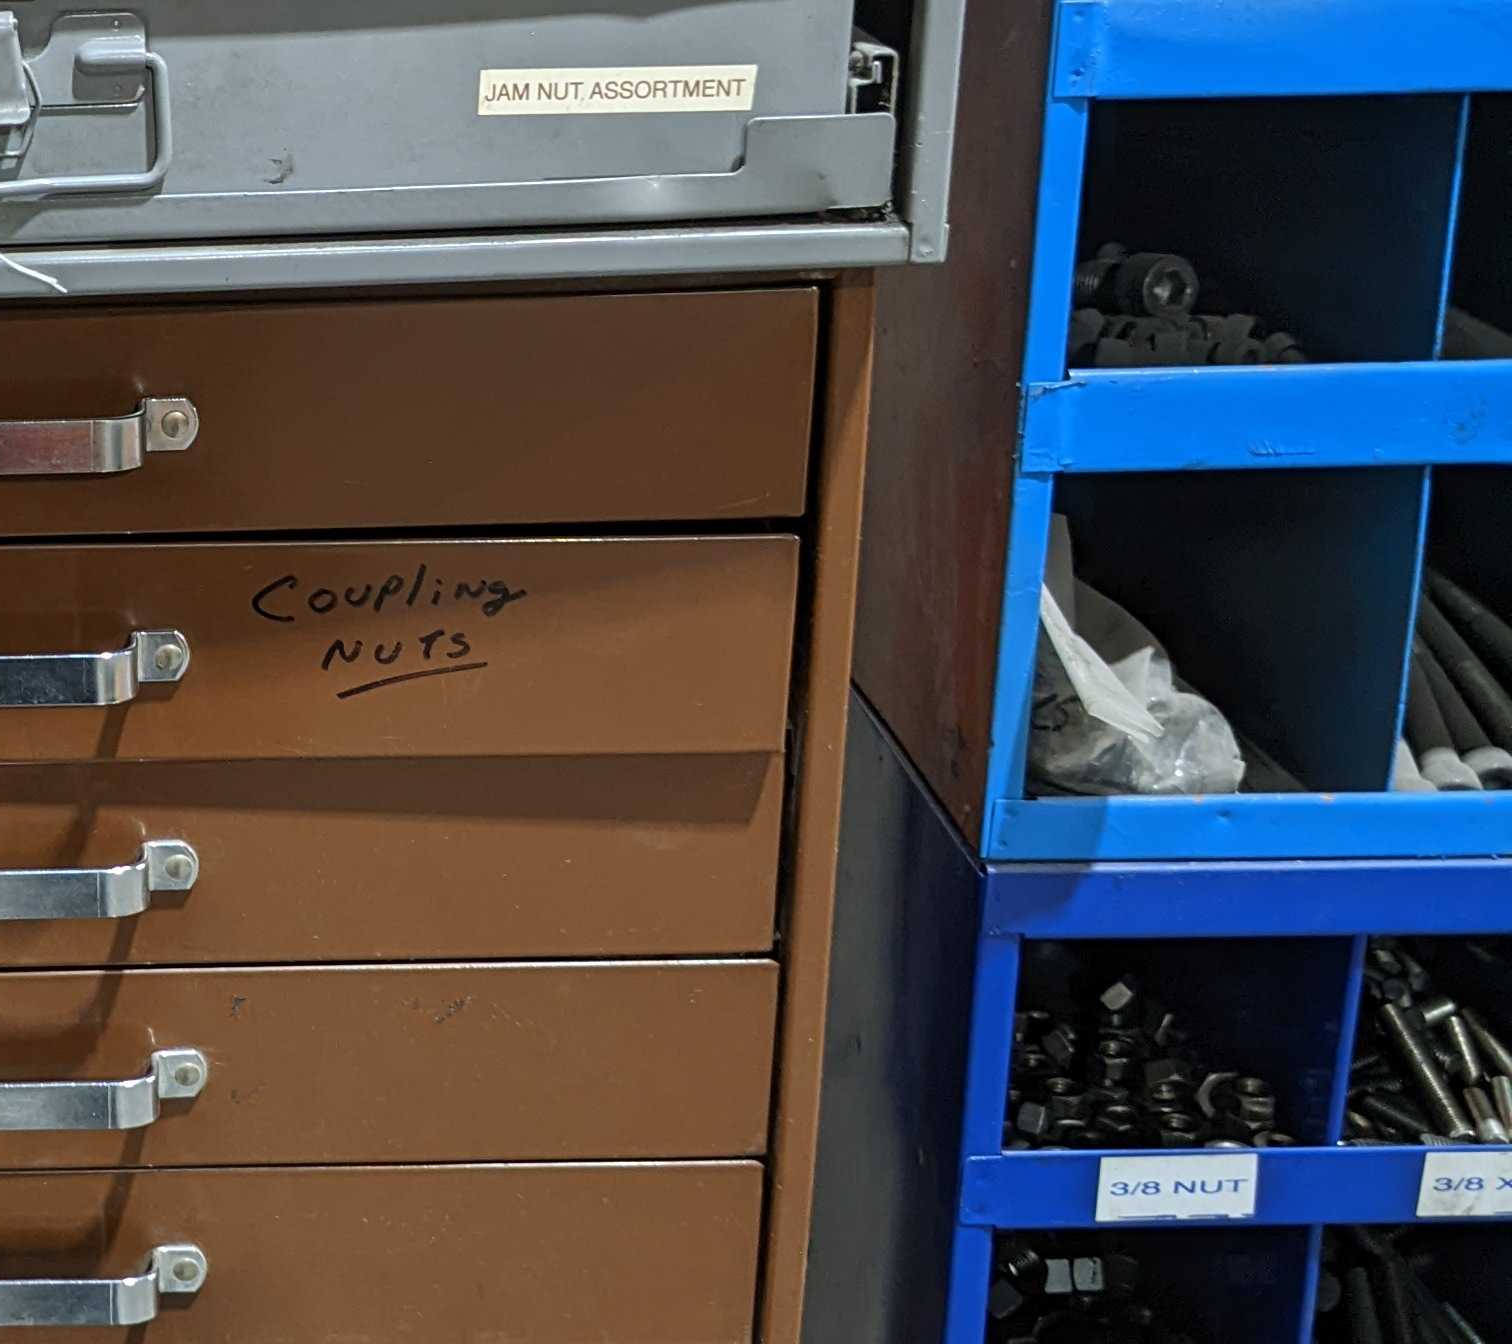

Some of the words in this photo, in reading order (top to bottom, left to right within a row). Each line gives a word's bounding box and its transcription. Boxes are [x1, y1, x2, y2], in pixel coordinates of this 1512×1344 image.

[484, 83, 529, 102] JAM
[537, 82, 584, 100] NUT
[589, 78, 747, 99] ASSORTMENT
[320, 629, 472, 671] NUTS
[1109, 1180, 1161, 1196] 3/8
[1173, 1178, 1249, 1194] NUT
[1433, 1177, 1484, 1191] 3/8
